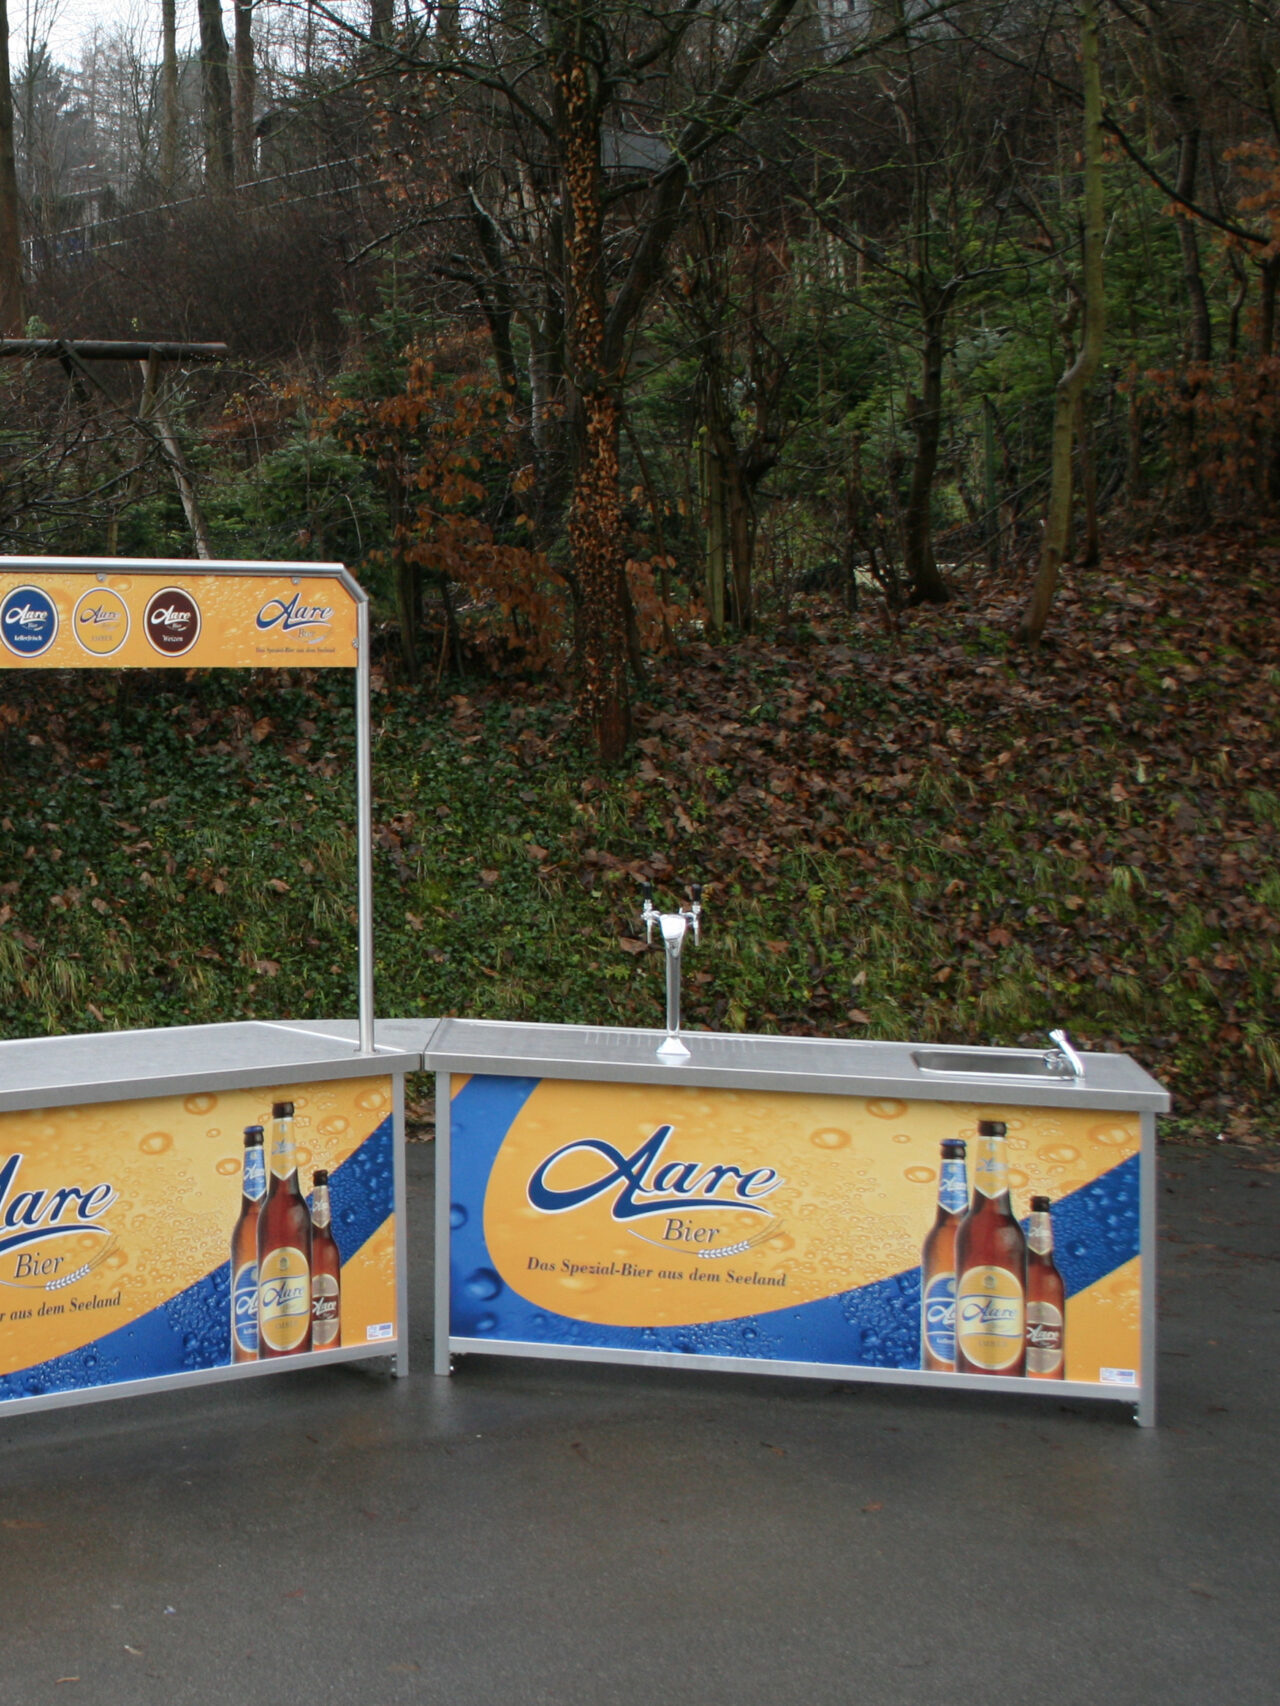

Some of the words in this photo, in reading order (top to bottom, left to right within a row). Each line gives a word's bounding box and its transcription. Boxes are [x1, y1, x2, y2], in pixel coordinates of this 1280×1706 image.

[5, 603, 48, 625] Aare
[151, 605, 191, 625] Aare
[256, 592, 335, 632] Aare
[527, 1124, 785, 1222] Aare
[662, 1218, 720, 1243] Bier
[13, 1252, 64, 1279] Bier
[527, 1257, 556, 1272] Das
[658, 1268, 684, 1281] aus
[689, 1265, 720, 1283] dem
[725, 1269, 787, 1287] Seeland
[10, 1309, 33, 1321] aus
[37, 1302, 65, 1317] dem
[69, 1292, 122, 1312] Seeland
[263, 1281, 305, 1307] Aare
[962, 1300, 1017, 1324] Aare
